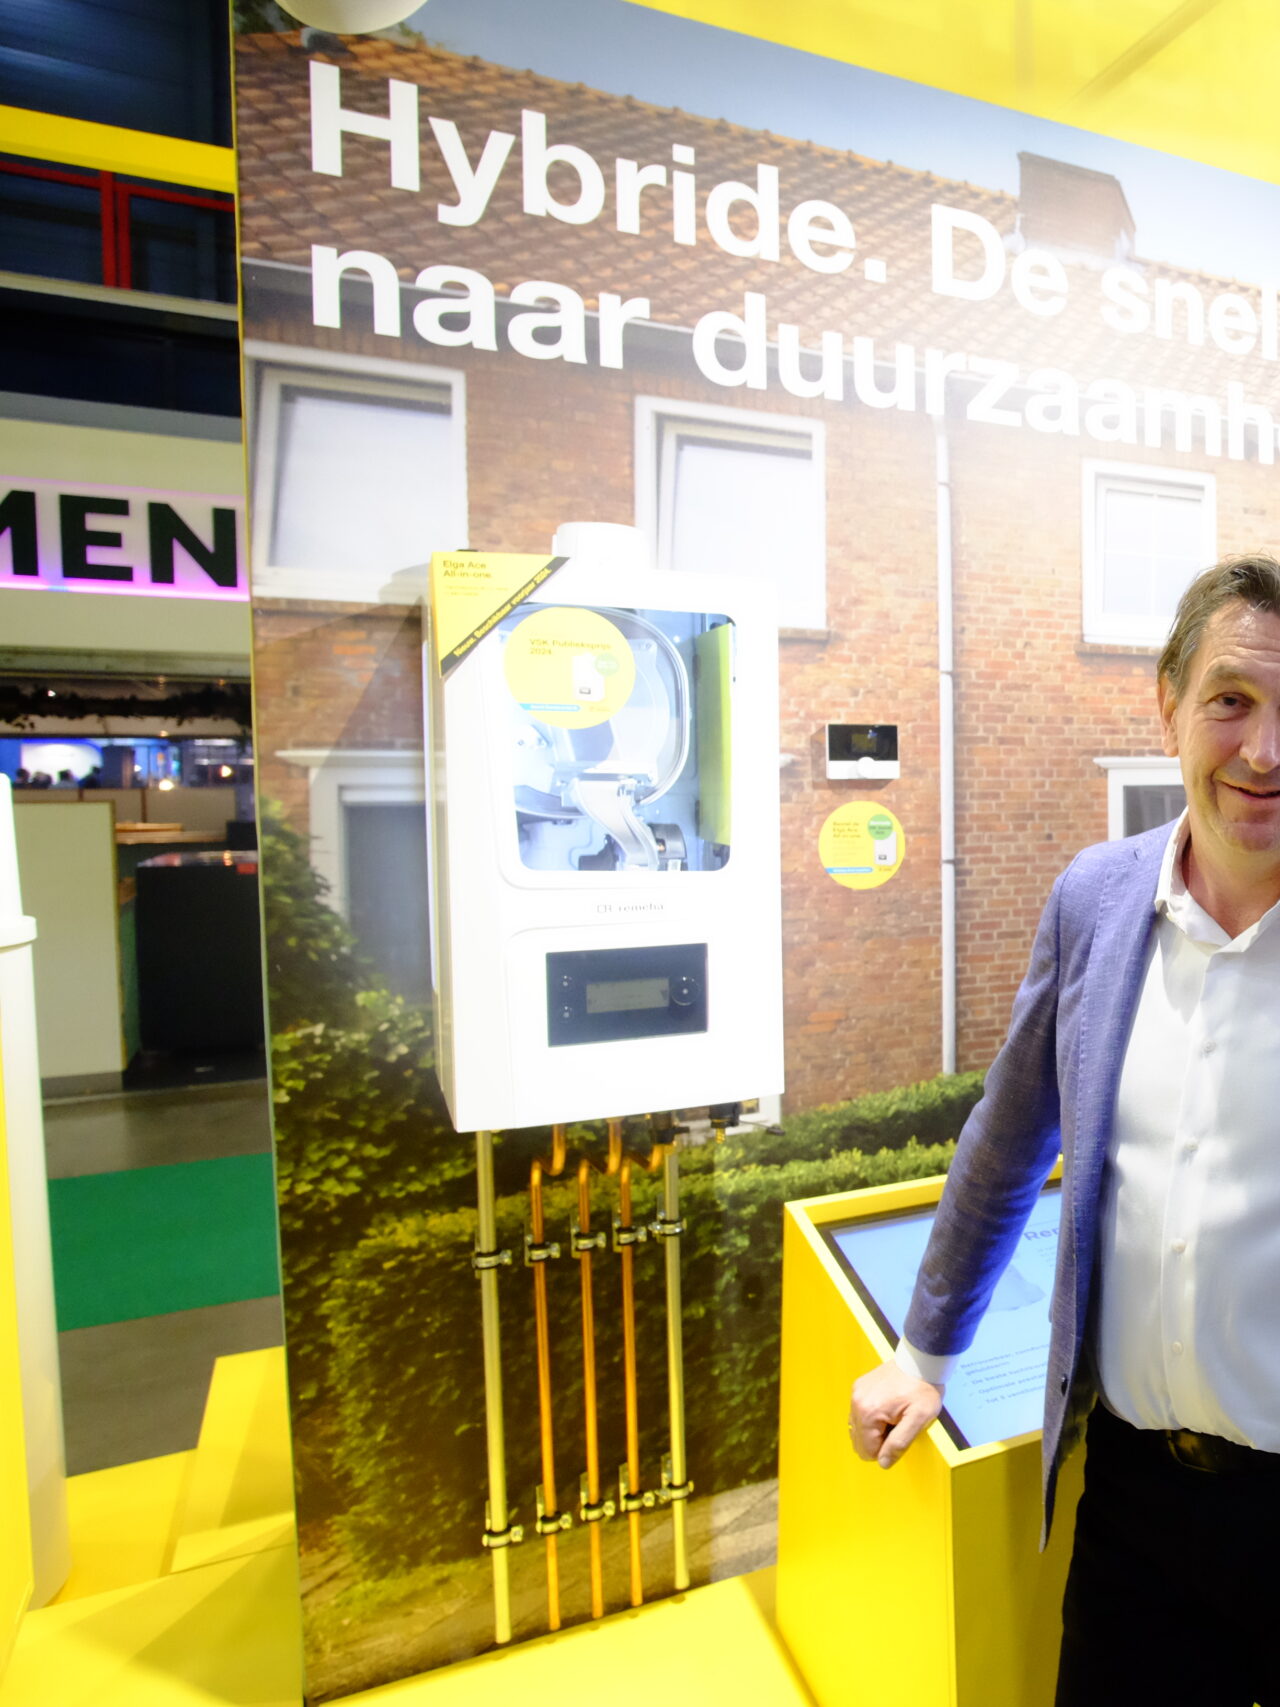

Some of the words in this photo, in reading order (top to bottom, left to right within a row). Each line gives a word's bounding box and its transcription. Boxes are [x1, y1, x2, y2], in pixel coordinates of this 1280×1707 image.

[309, 60, 887, 284] Hybride.
[930, 203, 1070, 317] De
[311, 244, 650, 370] naar
